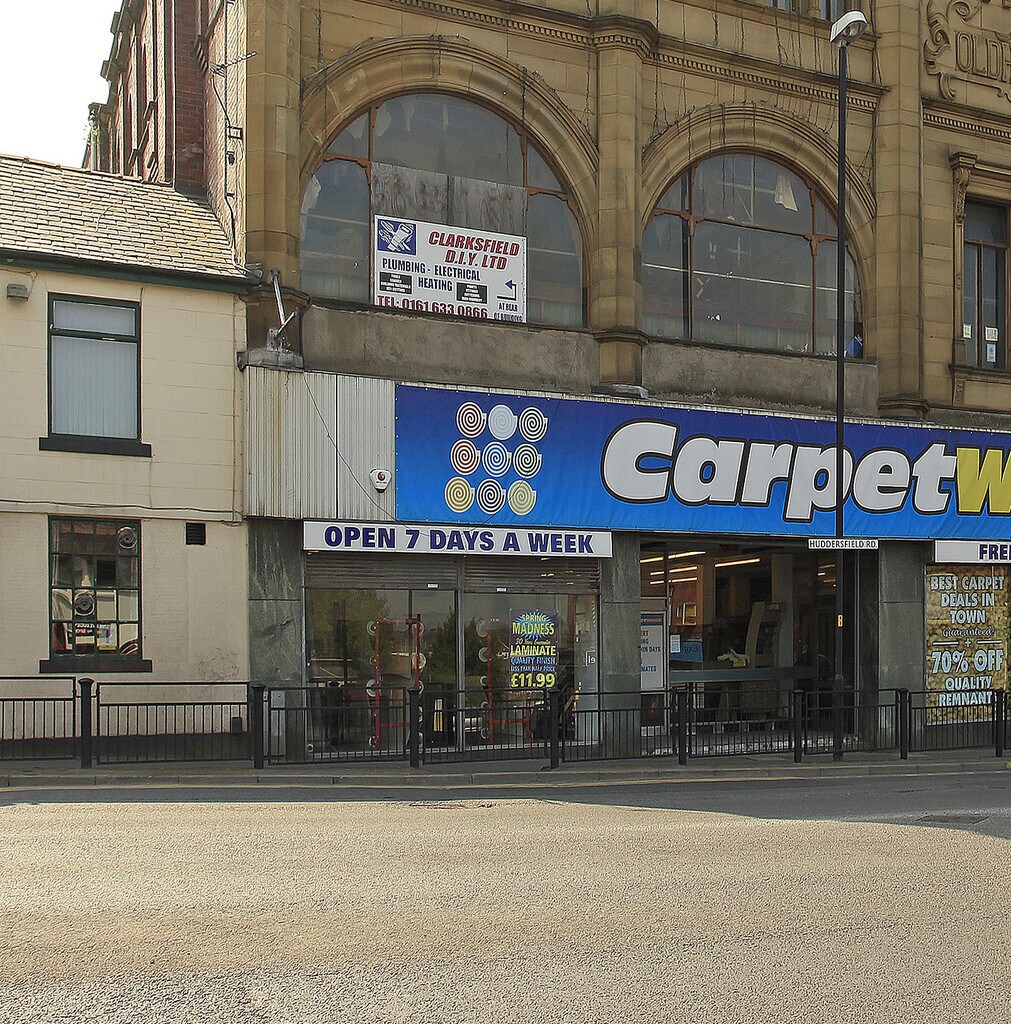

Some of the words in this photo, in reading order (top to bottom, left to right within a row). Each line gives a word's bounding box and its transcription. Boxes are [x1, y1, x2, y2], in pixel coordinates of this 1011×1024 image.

[428, 231, 520, 257] CLARKSFIELD
[445, 250, 478, 267] D.I.Y.
[482, 255, 507, 270] LTD
[382, 257, 426, 274] PLUMBING
[434, 265, 481, 281] ELECTRICAL
[418, 277, 453, 292] HEATING
[377, 296, 399, 309] TEL:
[401, 298, 428, 312] 0161
[431, 302, 455, 316] 633
[324, 526, 396, 549] OPEN
[405, 529, 420, 549] 7
[429, 529, 494, 552] DAYS
[502, 532, 521, 553] A
[527, 532, 594, 554] WEEK
[810, 540, 864, 548] HUDDERSFIELD
[930, 576, 959, 590] BEST
[961, 576, 1005, 590] CARPET
[941, 592, 978, 608] DEALS
[981, 592, 995, 607] IN
[521, 614, 547, 622] SPRING
[949, 609, 986, 624] TOWN
[512, 622, 555, 635] MADNESS
[510, 645, 556, 656] LAMINATE
[511, 656, 536, 665] QUALITY
[537, 656, 556, 665] FINISH
[932, 649, 969, 673] 70%
[973, 649, 1004, 672] OFF
[511, 672, 556, 688] £11.99
[945, 675, 992, 691] QUALITY
